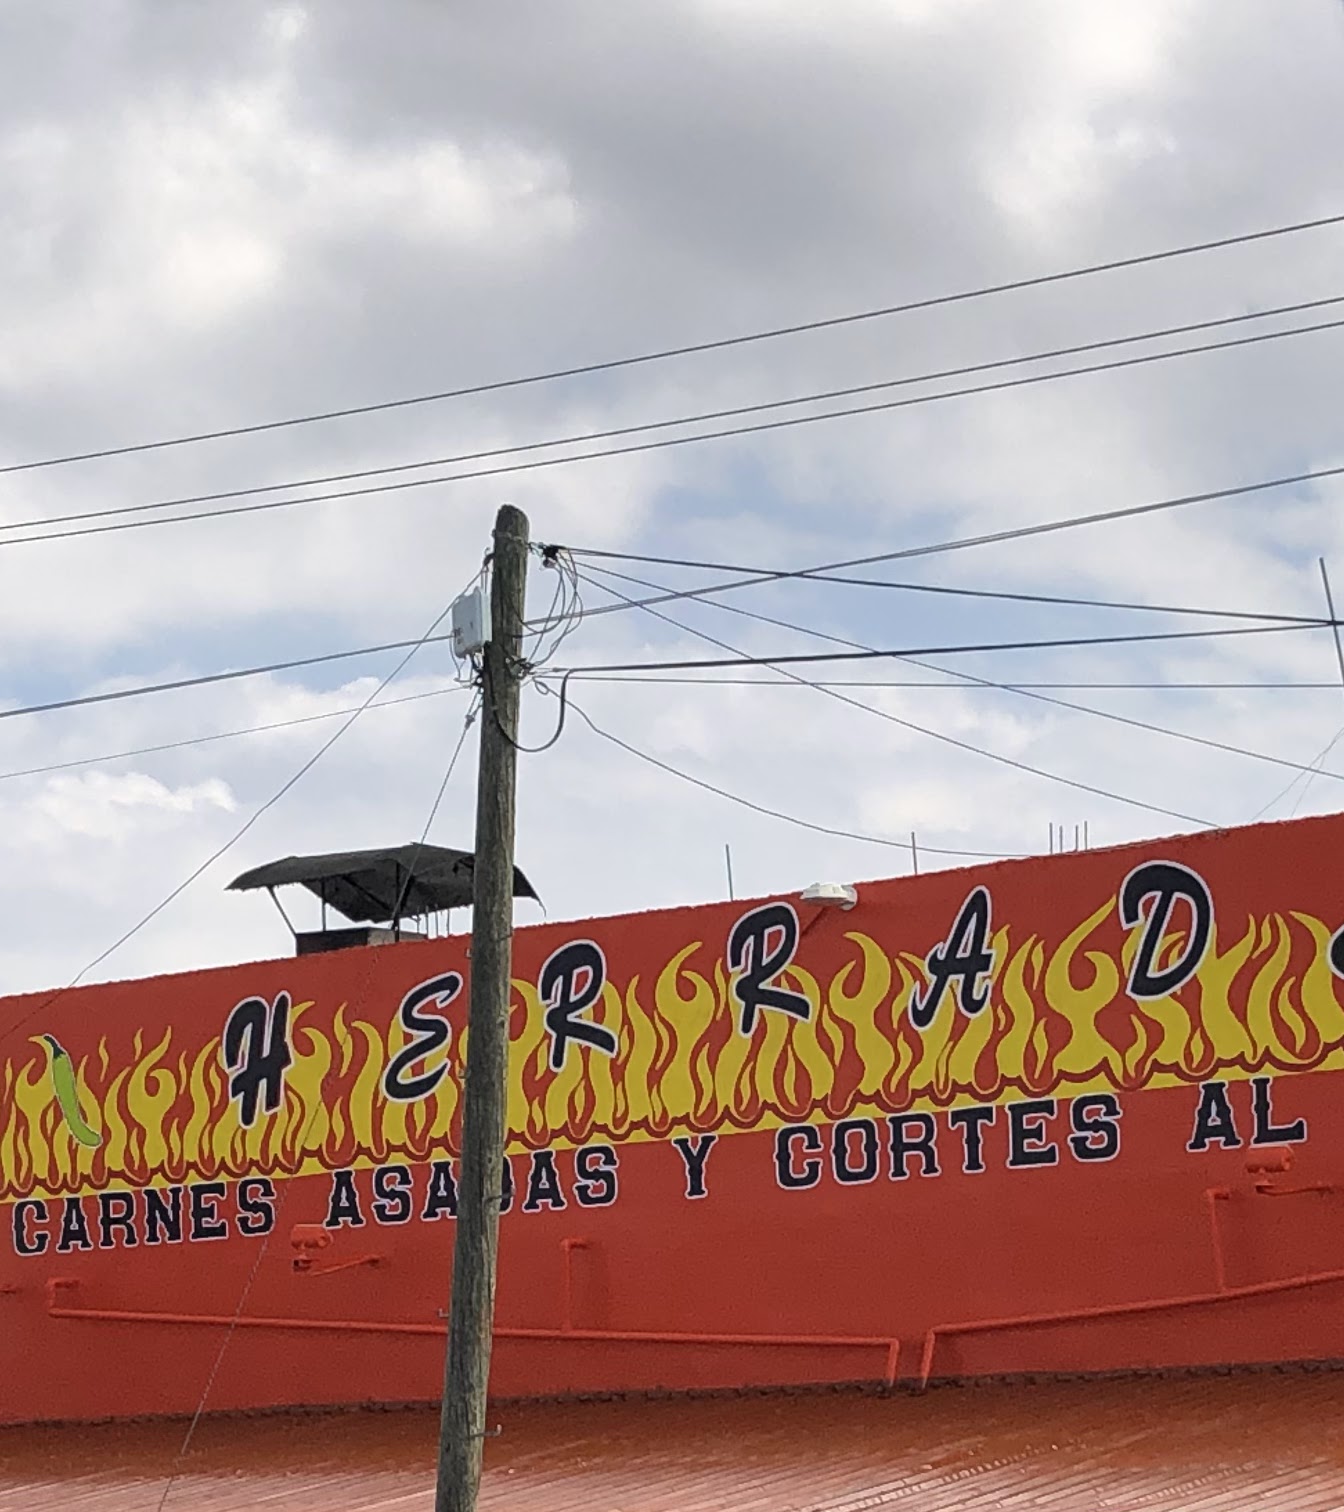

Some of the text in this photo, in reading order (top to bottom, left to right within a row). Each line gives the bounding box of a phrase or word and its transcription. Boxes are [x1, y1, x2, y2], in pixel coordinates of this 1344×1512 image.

[11, 1176, 276, 1256] CARNES
[673, 1135, 716, 1199] Y
[772, 1093, 1122, 1192] CORTES
[1185, 1075, 1307, 1153] AL
